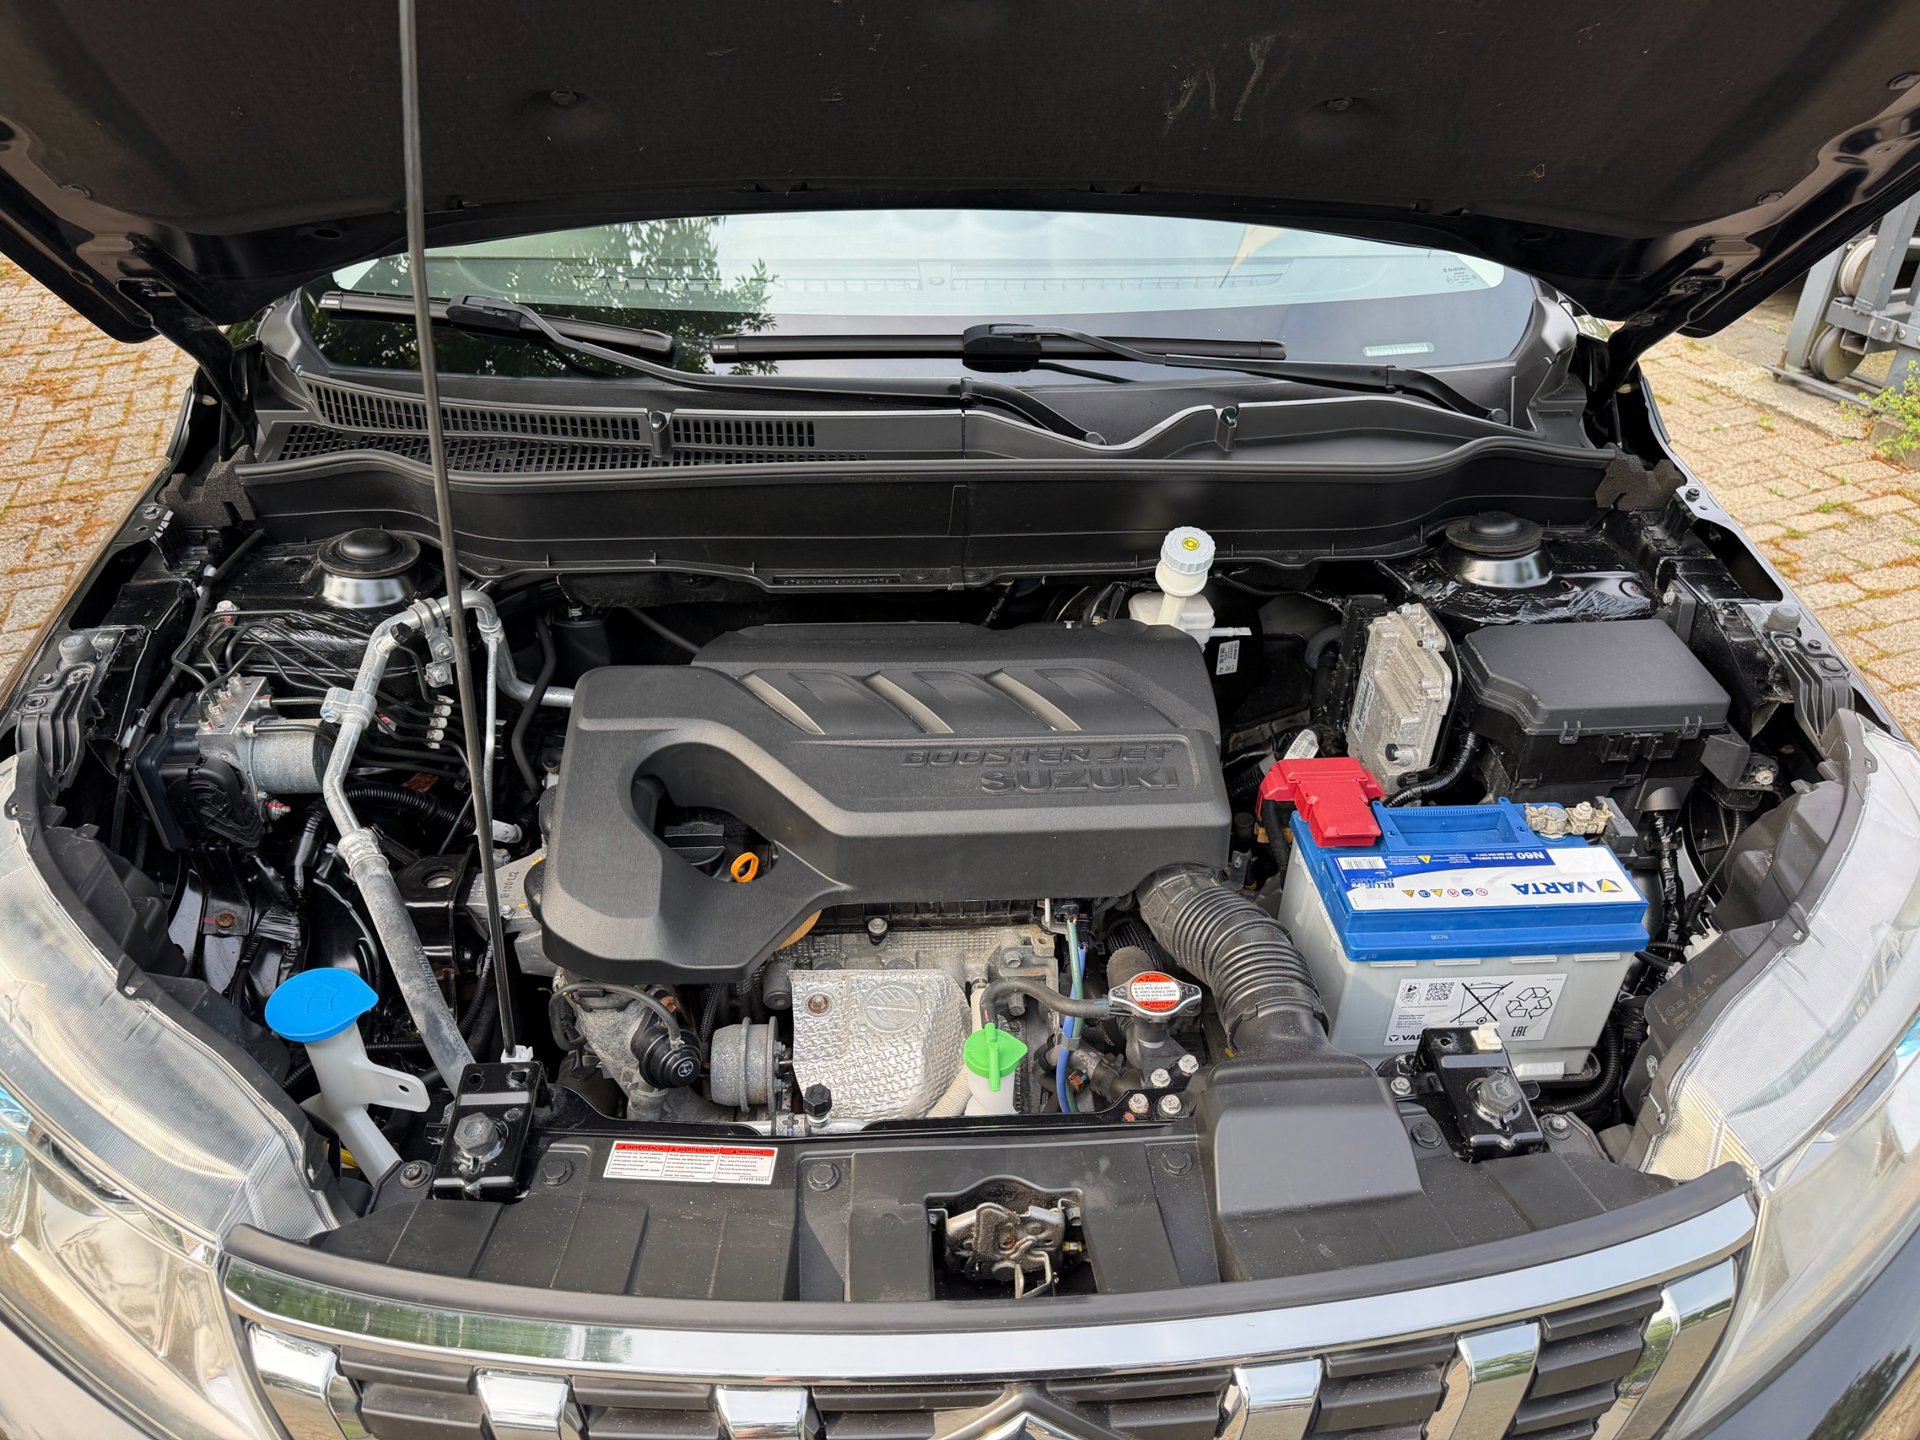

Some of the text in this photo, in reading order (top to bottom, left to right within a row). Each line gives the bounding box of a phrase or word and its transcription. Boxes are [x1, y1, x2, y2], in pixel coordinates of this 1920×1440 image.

[980, 765, 1180, 794] SUZUKI
[1510, 881, 1596, 895] VARTA
[1511, 1025, 1528, 1037] EAC
